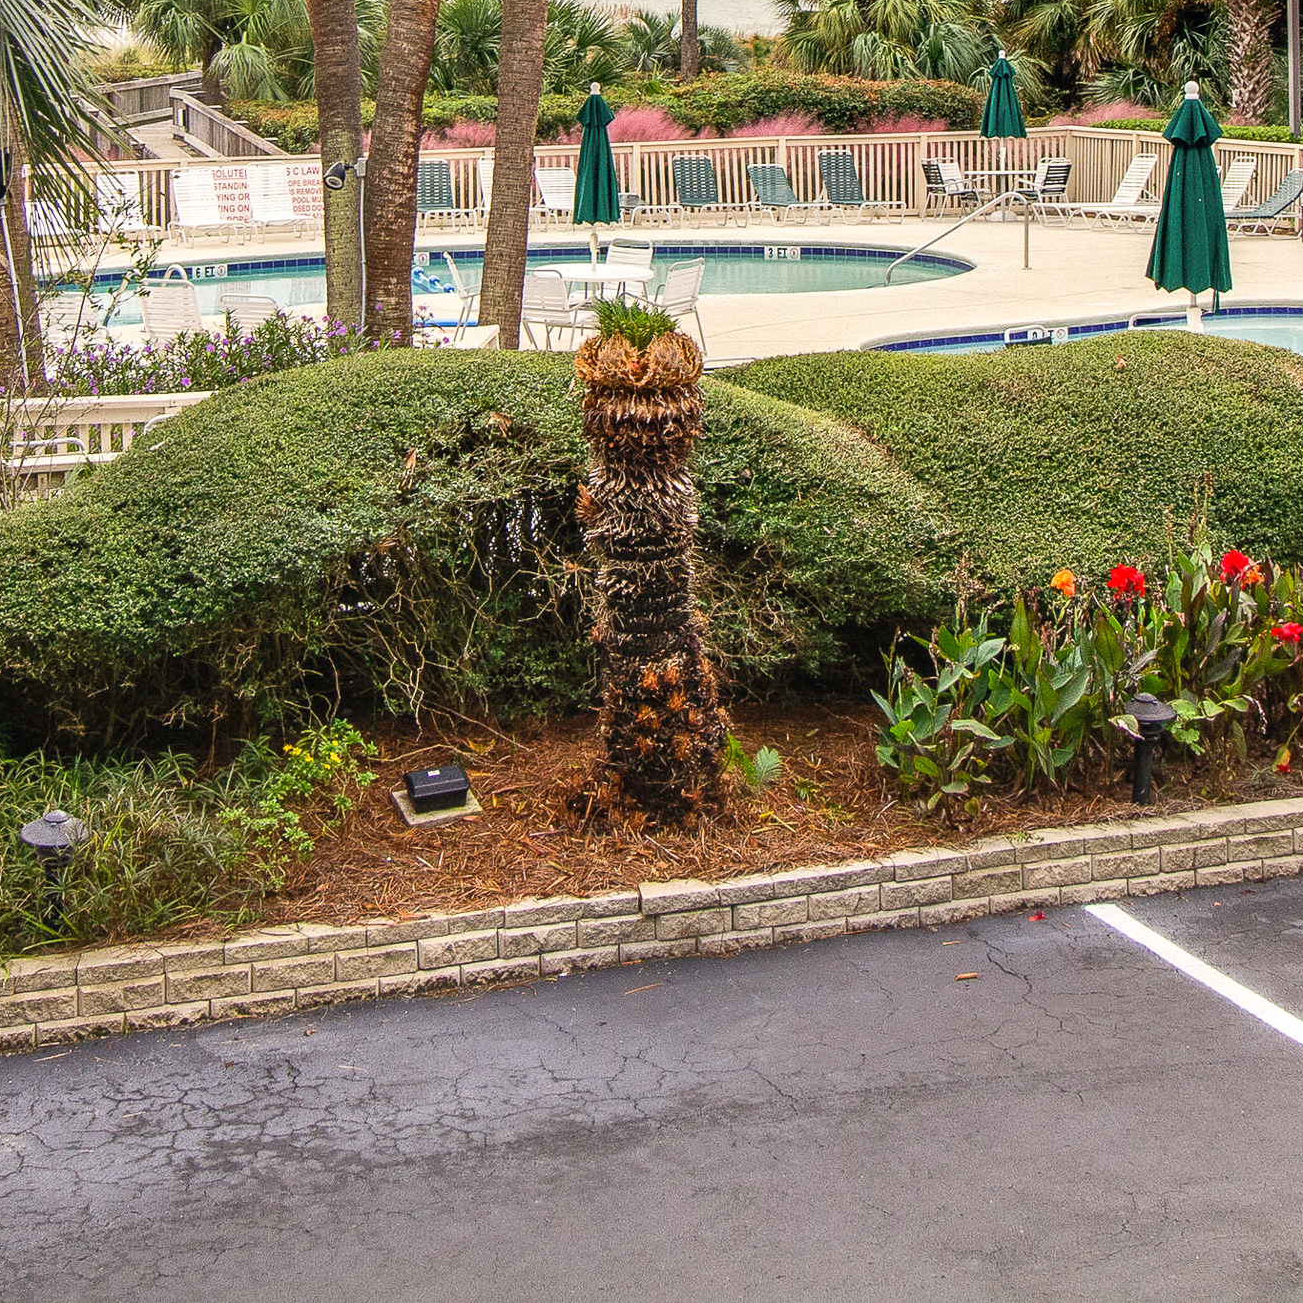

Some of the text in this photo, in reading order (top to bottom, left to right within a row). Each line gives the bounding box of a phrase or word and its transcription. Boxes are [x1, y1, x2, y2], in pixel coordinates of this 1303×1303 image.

[212, 169, 247, 178] SOLUTEL
[301, 166, 320, 175] LAW
[214, 182, 248, 190] STANDIN
[216, 193, 236, 201] YING
[238, 204, 250, 212] ON
[768, 247, 774, 258] 3
